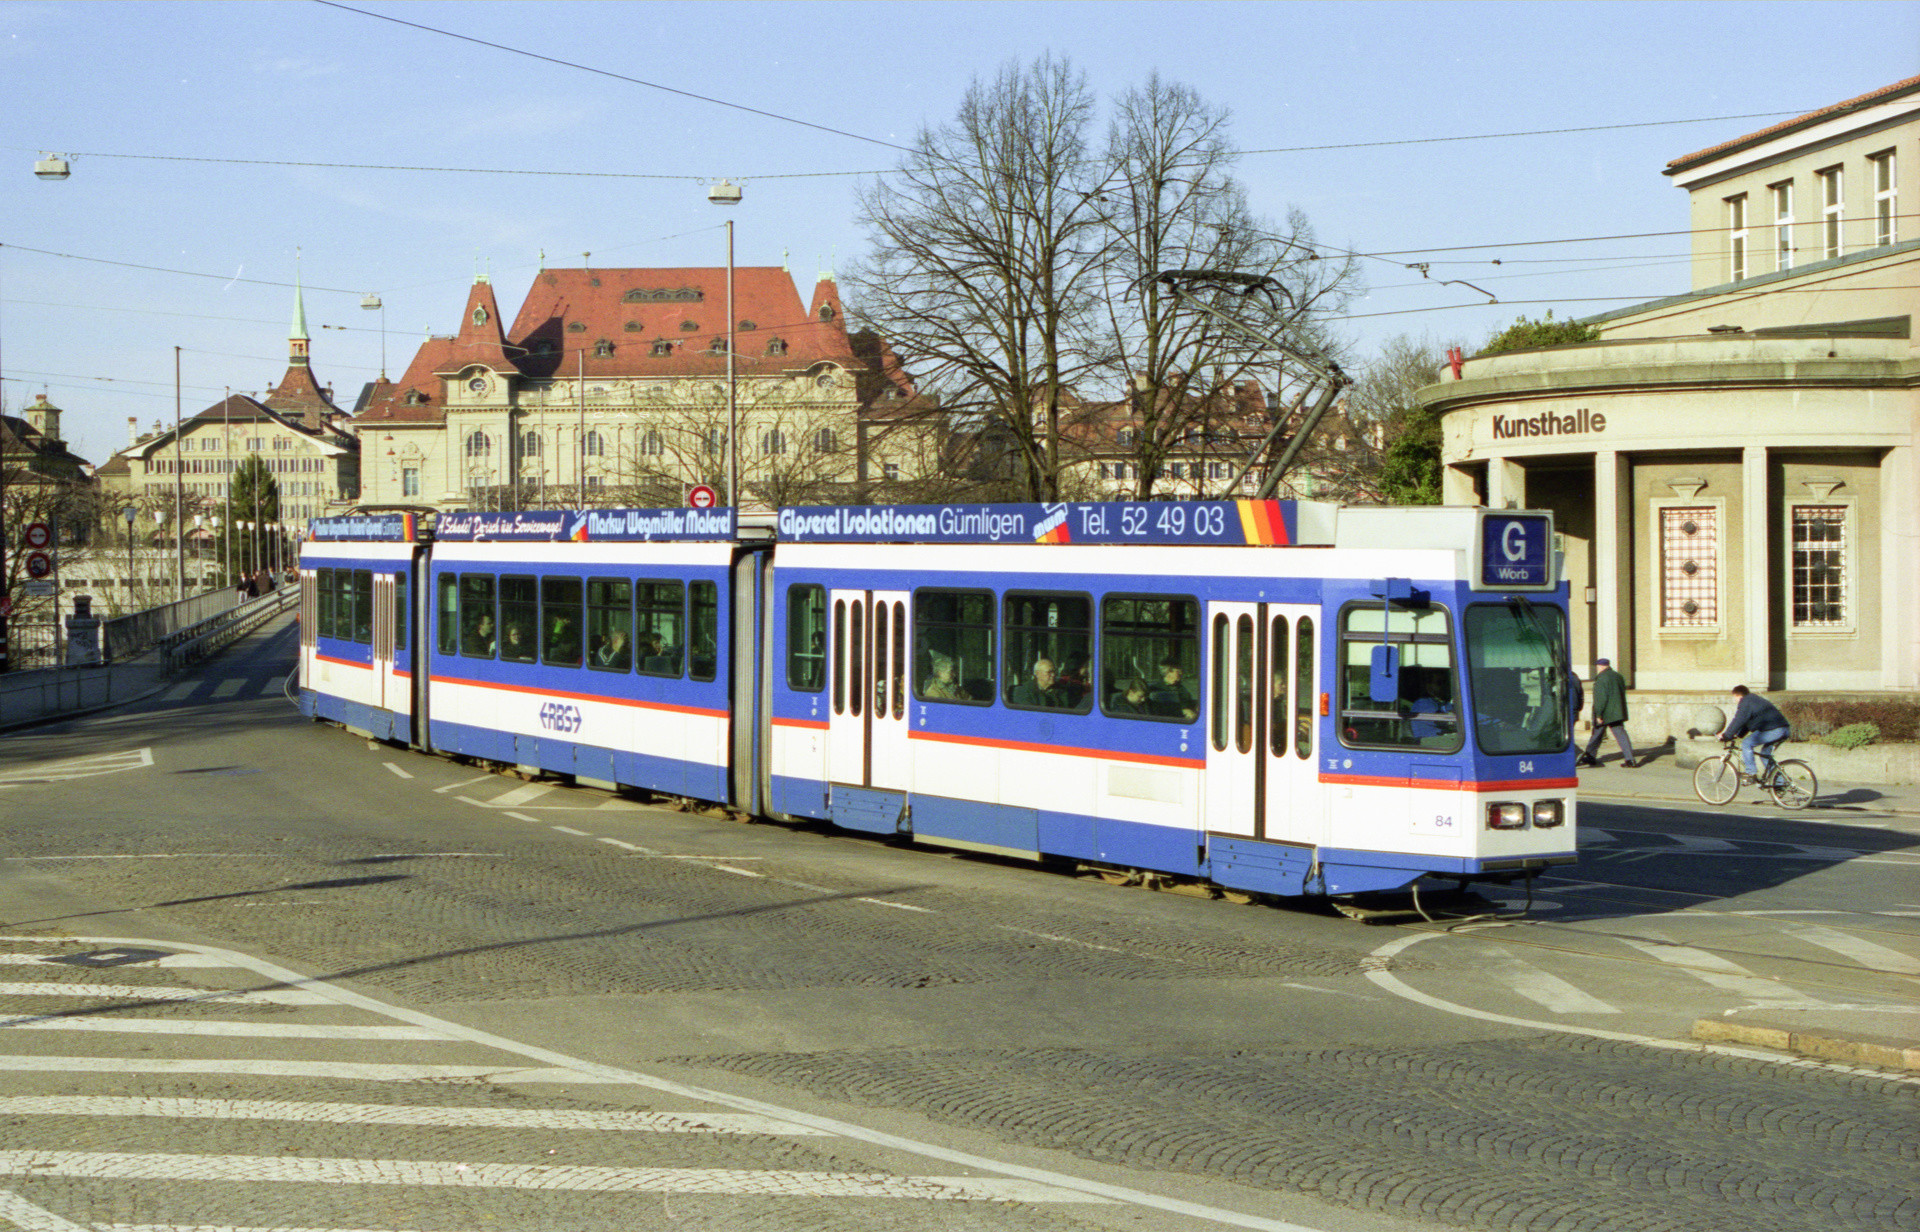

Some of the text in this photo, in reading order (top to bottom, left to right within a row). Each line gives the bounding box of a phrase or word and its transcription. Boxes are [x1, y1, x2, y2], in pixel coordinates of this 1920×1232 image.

[1493, 408, 1606, 439] Kunsthalle
[588, 511, 626, 534] Markus
[627, 510, 684, 540] Wegmüller
[685, 510, 731, 534] Malerei
[780, 507, 1024, 541] Gipserei Isolationen Gümligen
[1078, 506, 1224, 535] Tel. 52 49 03
[1502, 521, 1526, 562] G
[1498, 568, 1529, 580] Worb
[547, 702, 573, 732] RBS
[1519, 761, 1533, 773] 84
[1435, 815, 1452, 827] 84
